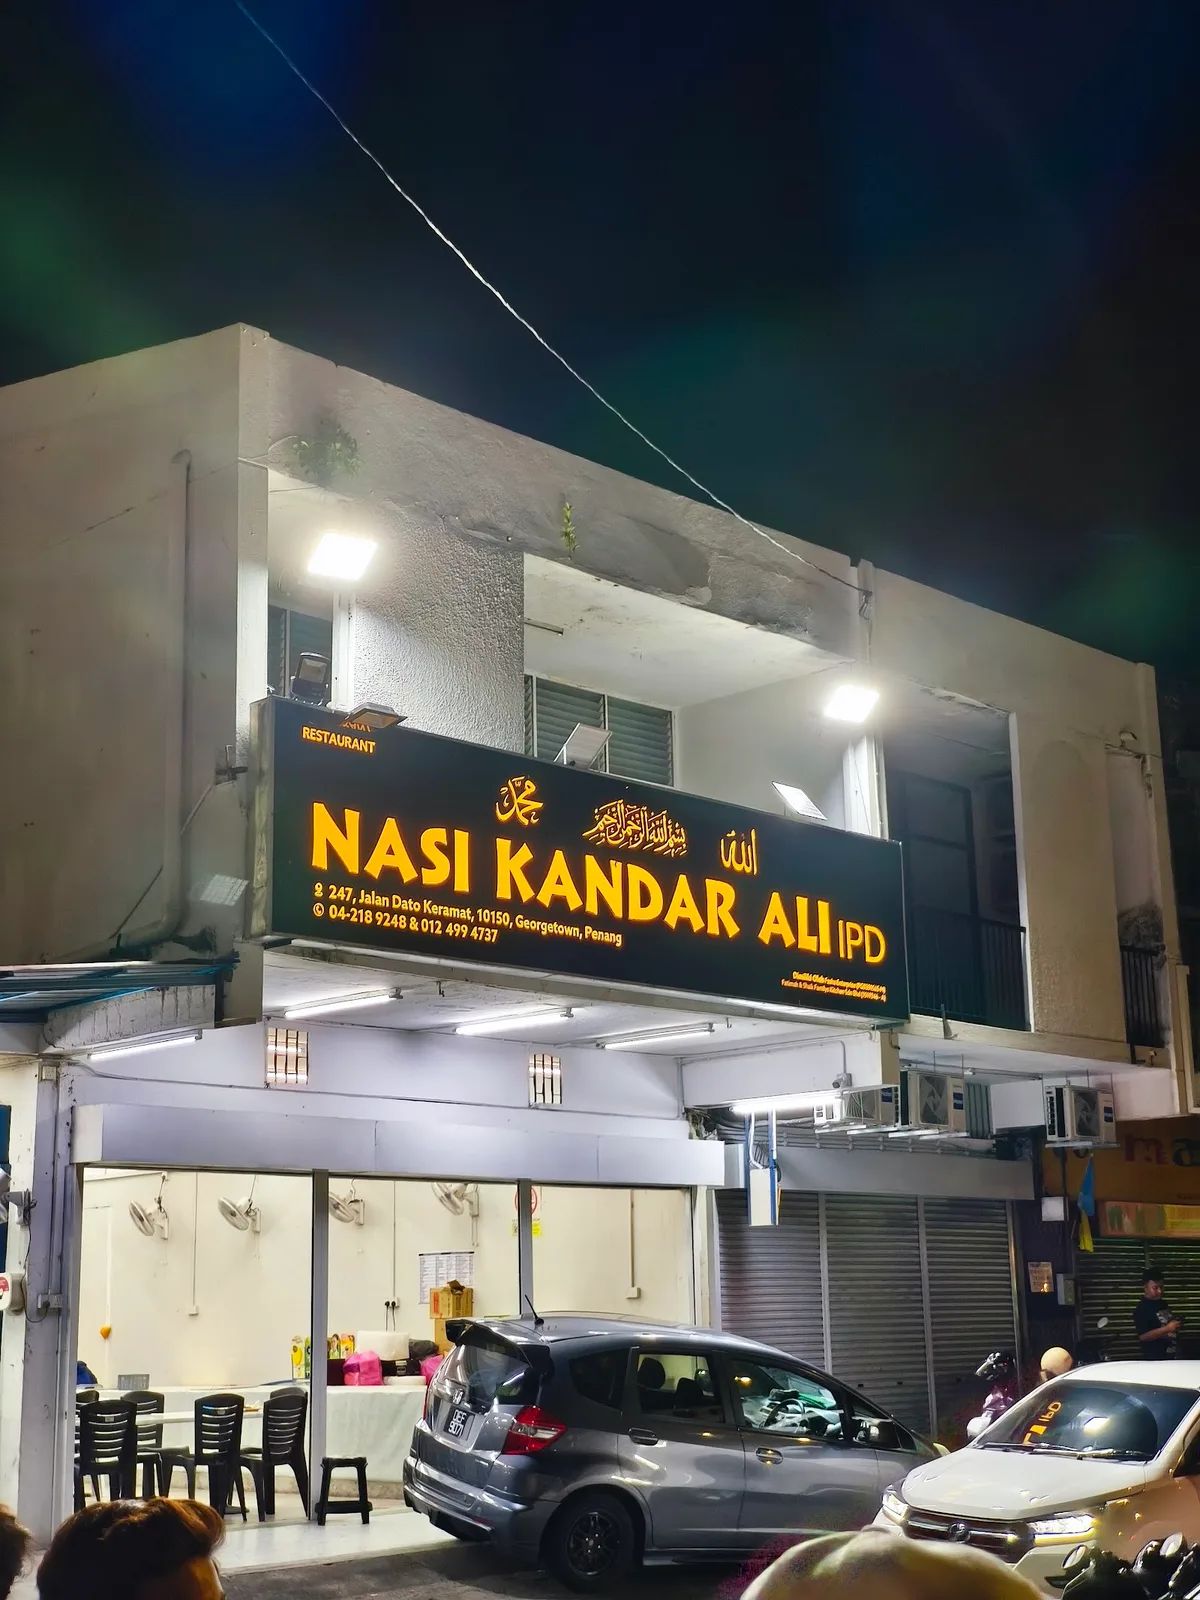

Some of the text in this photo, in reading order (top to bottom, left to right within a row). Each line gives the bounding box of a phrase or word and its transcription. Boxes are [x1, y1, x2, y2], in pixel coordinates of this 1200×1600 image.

[302, 726, 376, 754] RESTAURANT
[311, 801, 887, 963] NASI KANDAR ALI IPD
[328, 884, 622, 948] 247, Jalan Dato Keramat, 10150, Georgetown, Penang
[328, 904, 499, 943] 04-218 9248 & 012 499 4737
